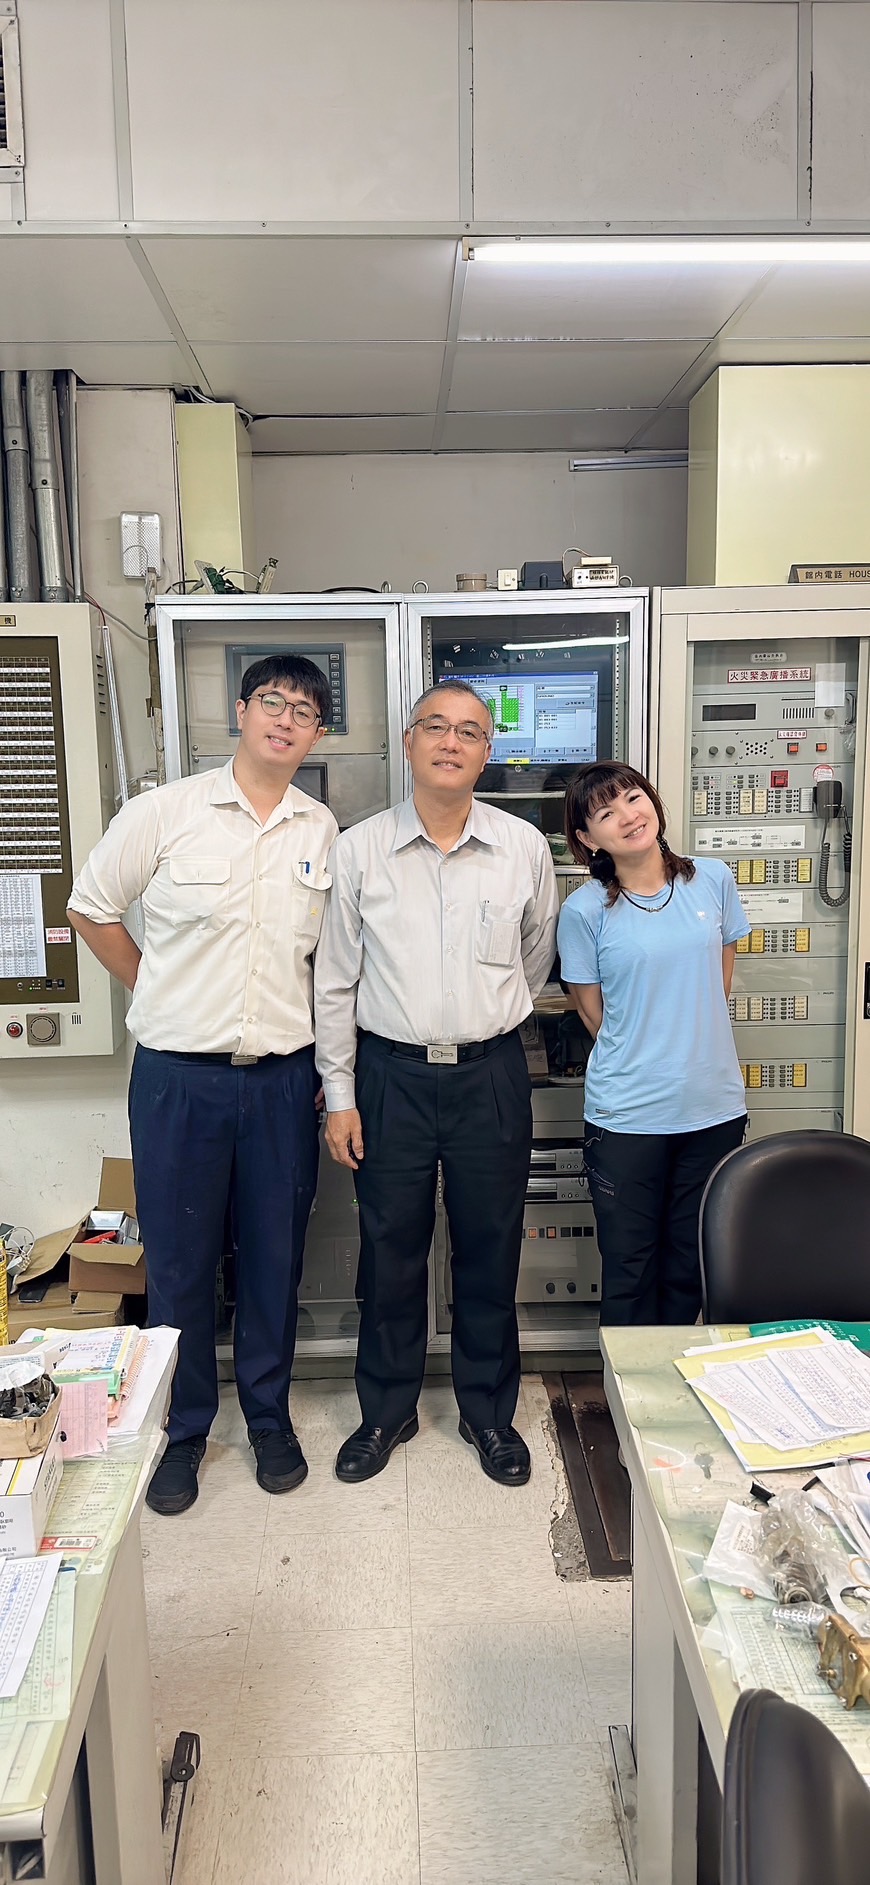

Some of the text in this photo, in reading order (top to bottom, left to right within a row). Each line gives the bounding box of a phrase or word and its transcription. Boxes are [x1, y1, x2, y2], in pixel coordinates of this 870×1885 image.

[805, 570, 842, 579] 館內電話
[730, 669, 809, 681] 火災緊急廣播系統
